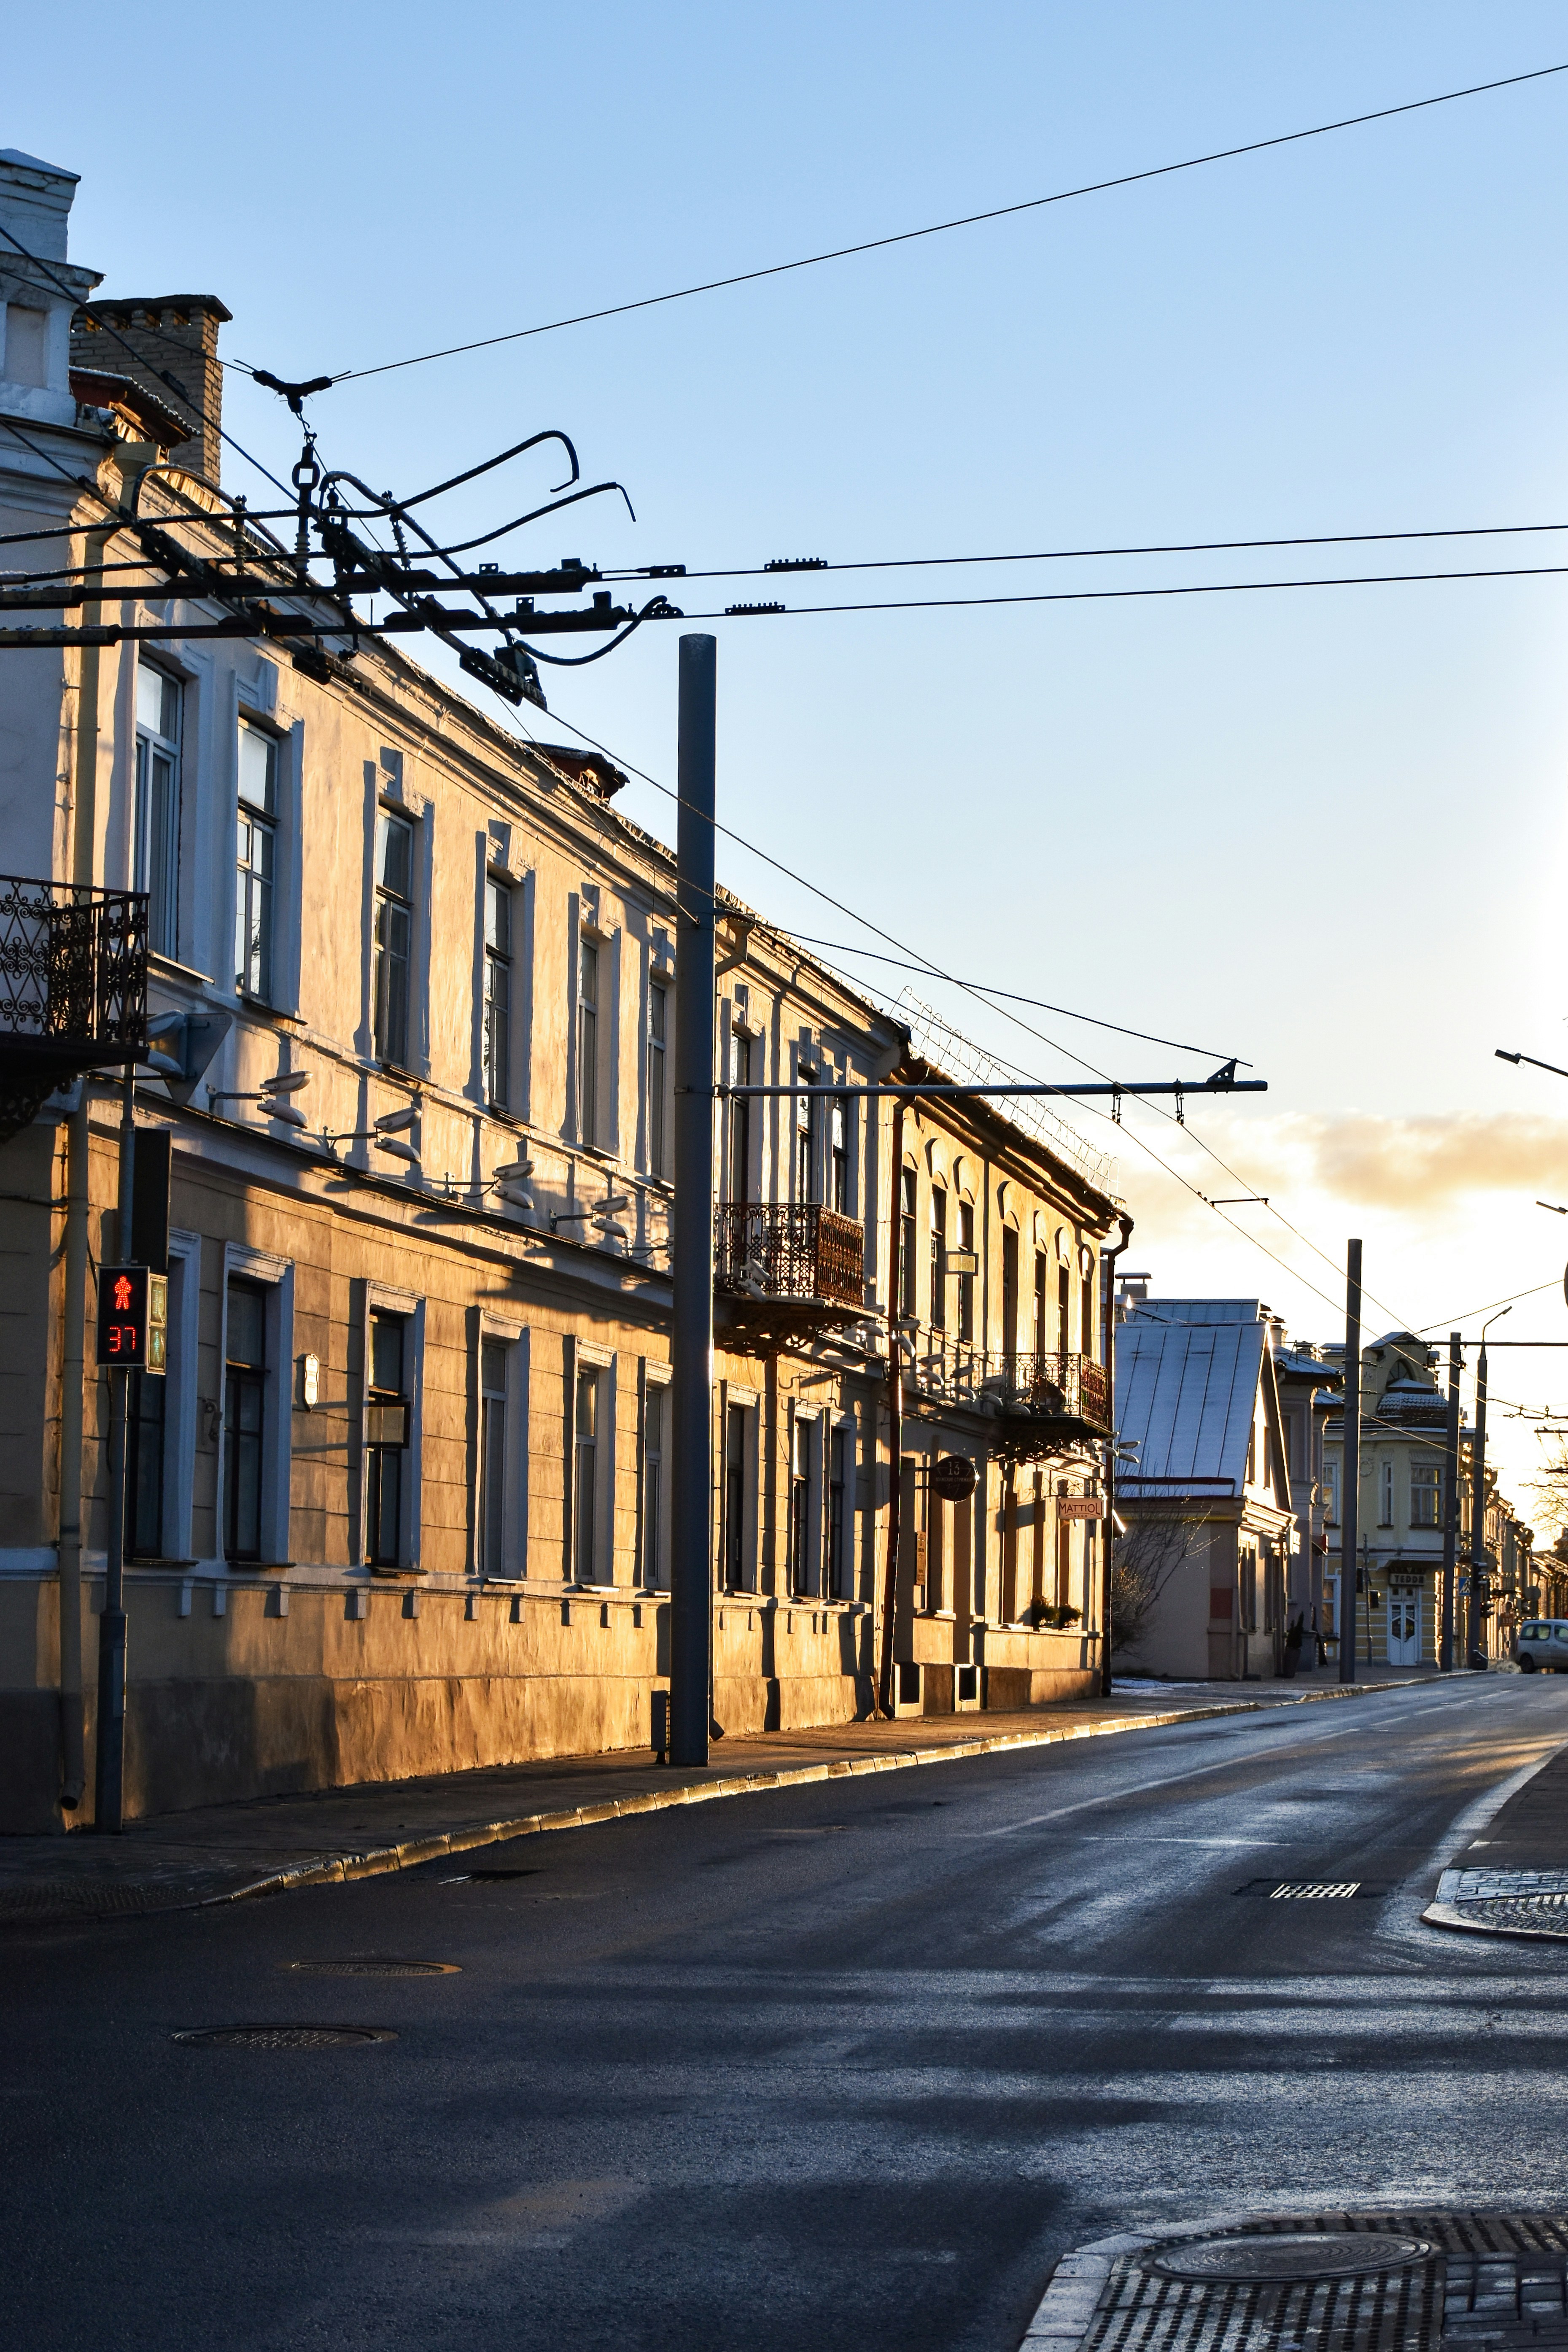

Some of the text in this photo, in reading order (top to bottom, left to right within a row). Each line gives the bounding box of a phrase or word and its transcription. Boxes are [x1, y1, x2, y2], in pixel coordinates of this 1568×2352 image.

[110, 1327, 135, 1351] 37
[948, 1462, 959, 1475] 13
[1059, 1502, 1102, 1516] MATTIOLI
